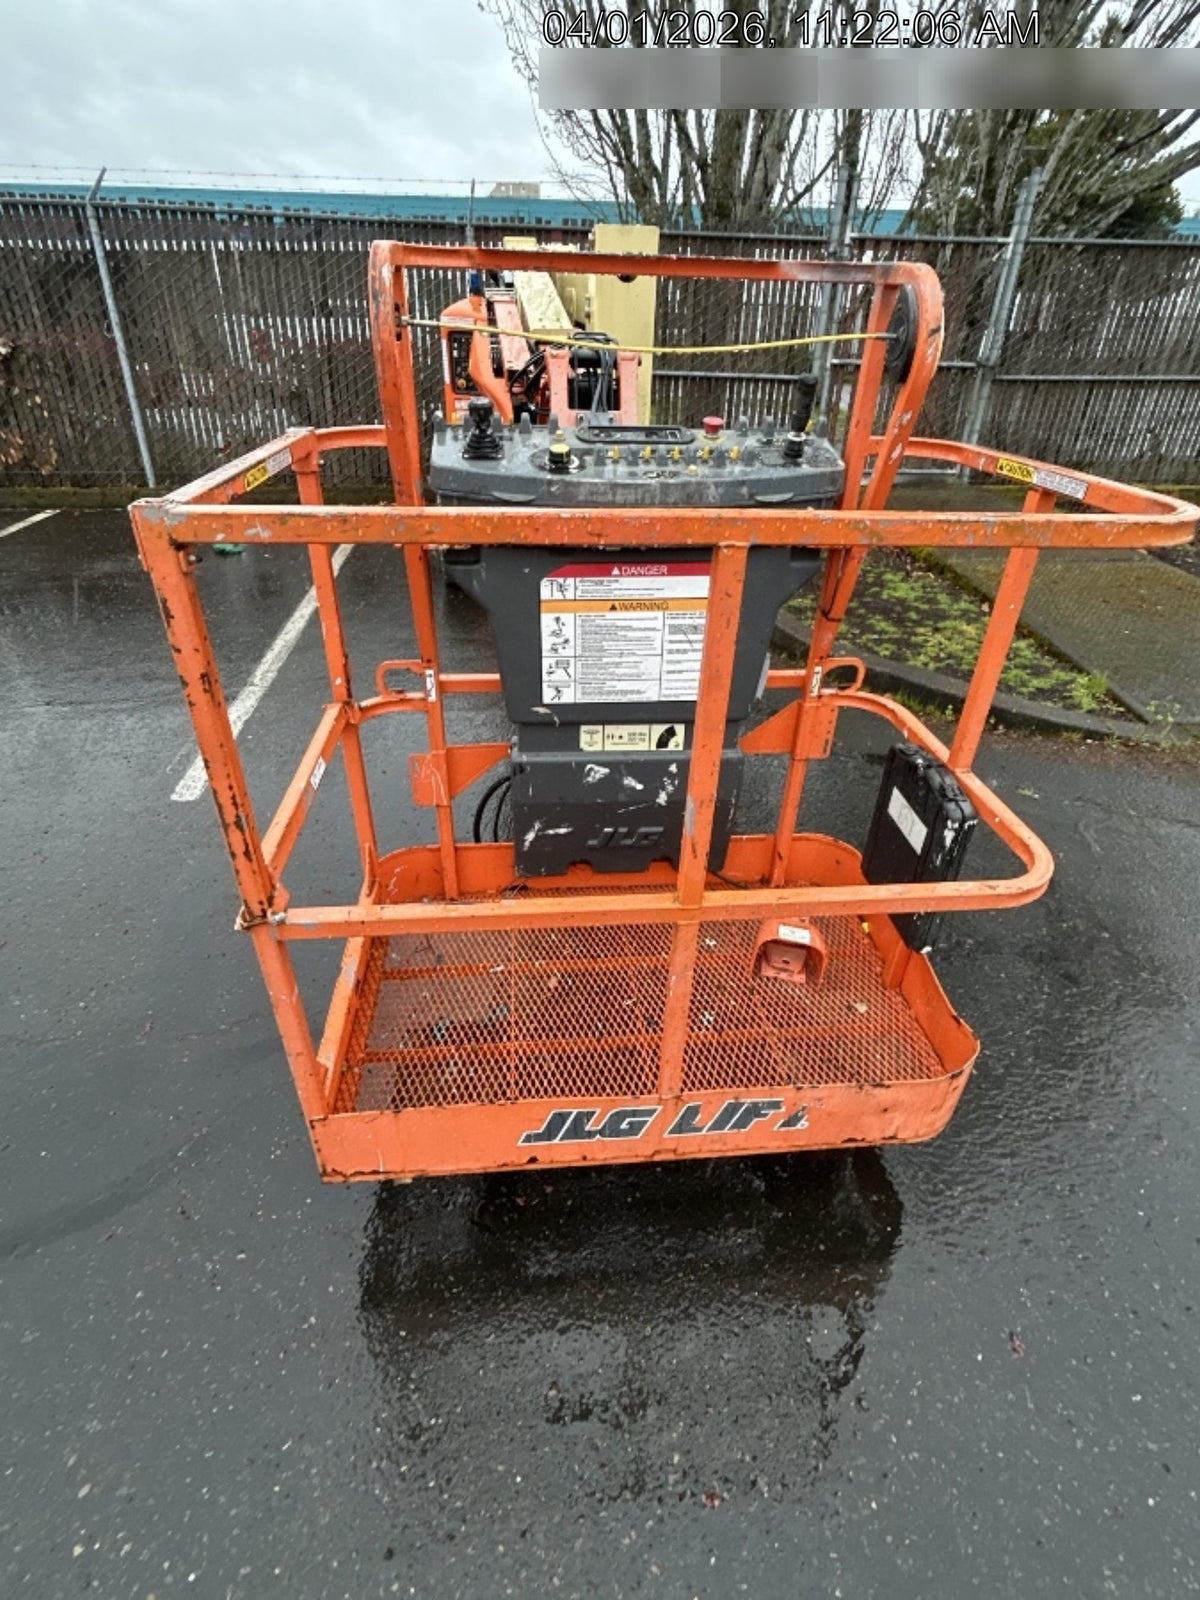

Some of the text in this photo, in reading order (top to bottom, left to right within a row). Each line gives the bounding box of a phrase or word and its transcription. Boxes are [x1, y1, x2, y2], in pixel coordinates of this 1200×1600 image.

[621, 565, 668, 576] DANGER
[618, 601, 670, 611] WARNING
[586, 826, 664, 847] JLG
[517, 1105, 663, 1146] JLG
